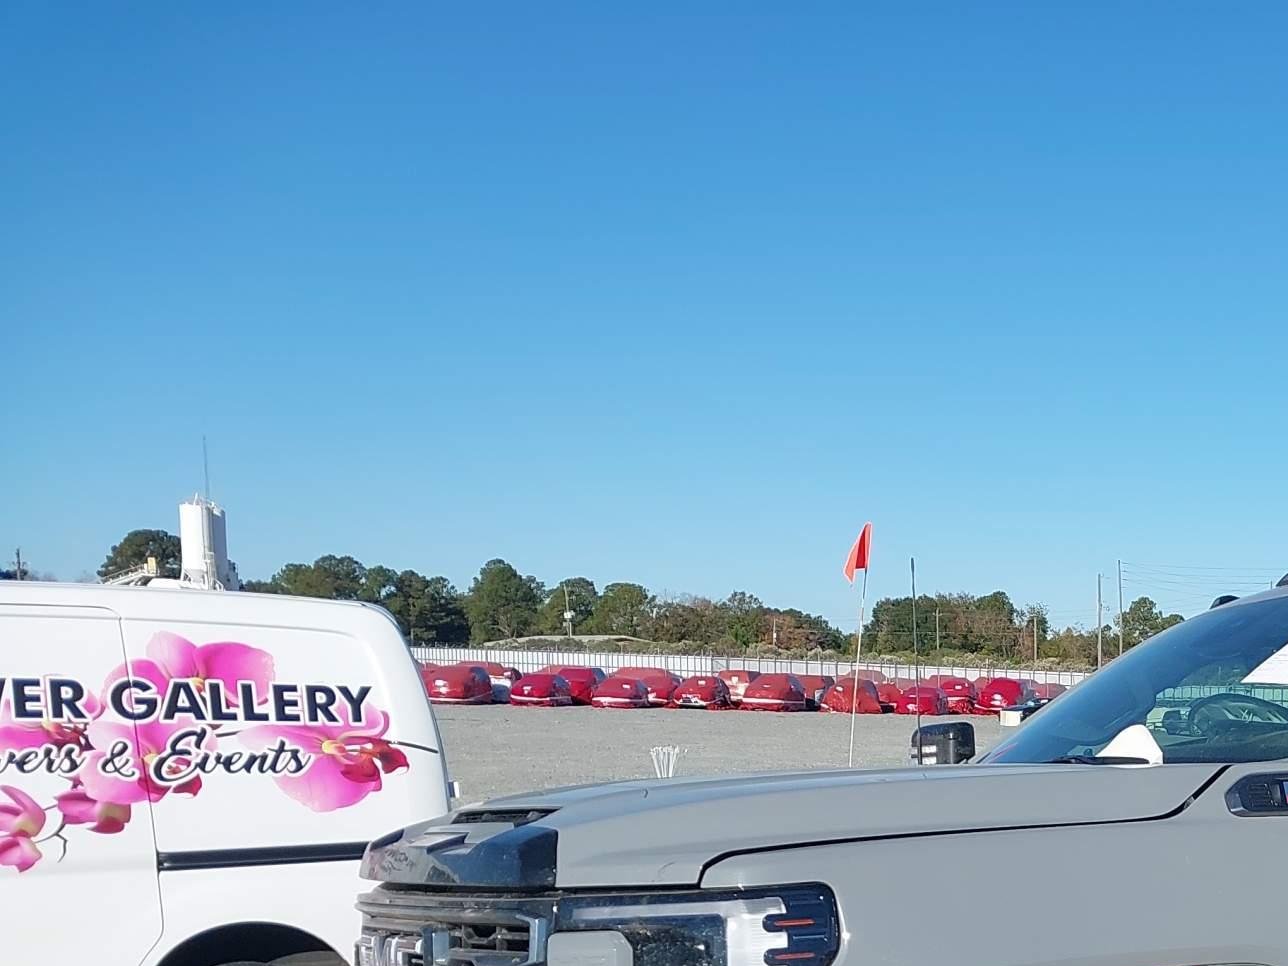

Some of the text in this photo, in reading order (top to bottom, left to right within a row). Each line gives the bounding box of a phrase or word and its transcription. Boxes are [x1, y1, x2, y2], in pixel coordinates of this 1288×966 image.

[0, 678, 372, 723] ER GALLERY
[101, 740, 136, 778] &
[153, 727, 311, 783] Events
